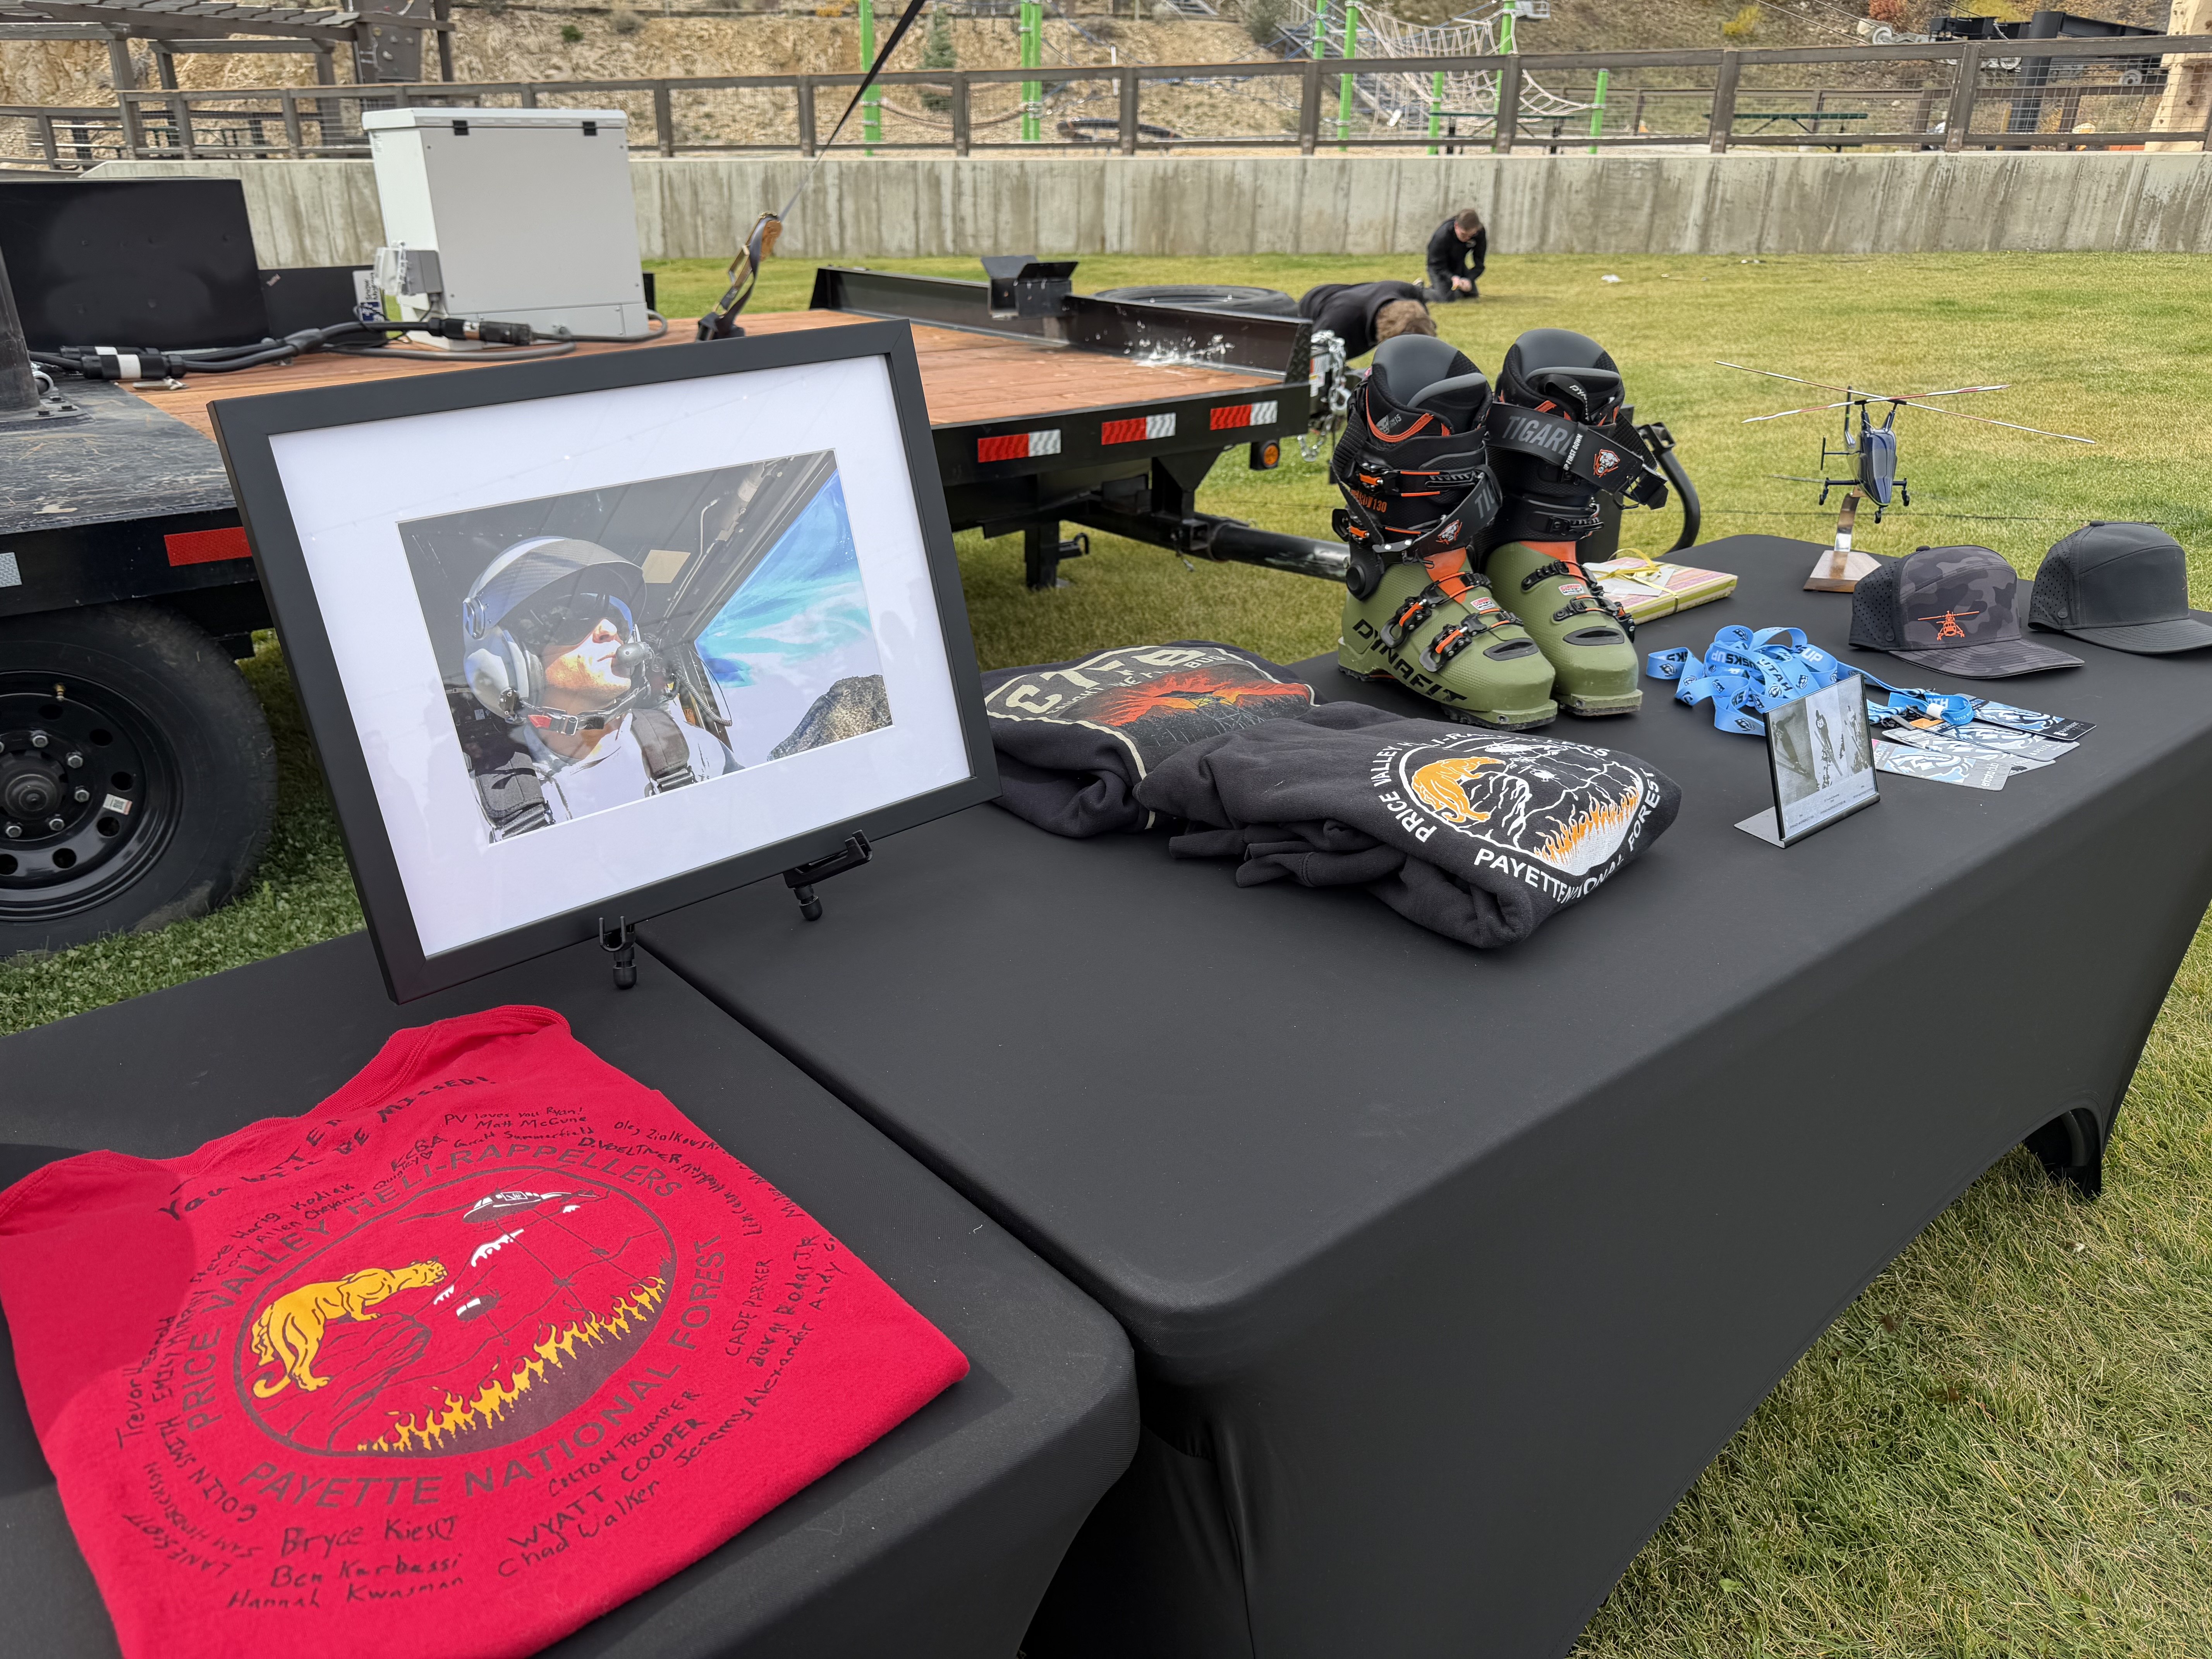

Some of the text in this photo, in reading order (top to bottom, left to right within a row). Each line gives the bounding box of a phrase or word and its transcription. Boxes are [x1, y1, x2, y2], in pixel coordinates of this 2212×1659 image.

[1566, 449, 1577, 465] FIRST
[1572, 433, 1583, 450] DOWN
[1372, 498, 1388, 513] 130
[1182, 655, 1227, 669] BUG
[1757, 659, 1793, 692] UTAH
[1370, 743, 1402, 787] VALLEY
[2035, 744, 2053, 754] DELTA
[1379, 791, 1438, 843] PRICE
[1474, 848, 1567, 902] PAYETTE
[1627, 767, 1661, 851] FOREST
[444, 1113, 467, 1126] PV
[518, 1111, 540, 1119] you
[546, 1106, 584, 1116] Ryan!
[474, 1120, 512, 1130] Matt
[155, 1187, 232, 1221] You
[332, 1127, 370, 1155] BE
[377, 1076, 497, 1123] MISSED!
[290, 1183, 355, 1211] Kodiak
[256, 1221, 302, 1244] Allen
[189, 1244, 234, 1283] Steve
[809, 1261, 848, 1312] Andy
[182, 1144, 683, 1432] PRICE VALLEY HELI-RAPPELLERS
[725, 1259, 774, 1356] CADE PARKER
[163, 1289, 217, 1348] MURPHY
[151, 1352, 183, 1403] EMILY
[238, 1234, 725, 1508] PAYETTE NATIONAL FOREST
[115, 1379, 145, 1450] Trevor
[673, 1322, 814, 1468] Jeremy Alexander
[155, 1414, 197, 1468] SMITH
[613, 1388, 704, 1451] TRUMPER
[507, 1418, 709, 1548] WYATT COOPER
[577, 1479, 660, 1538] Walker
[167, 1547, 233, 1579] LANE
[280, 1527, 364, 1559] Bryce
[226, 1588, 321, 1609] Hannah
[270, 1565, 323, 1588] Ben
